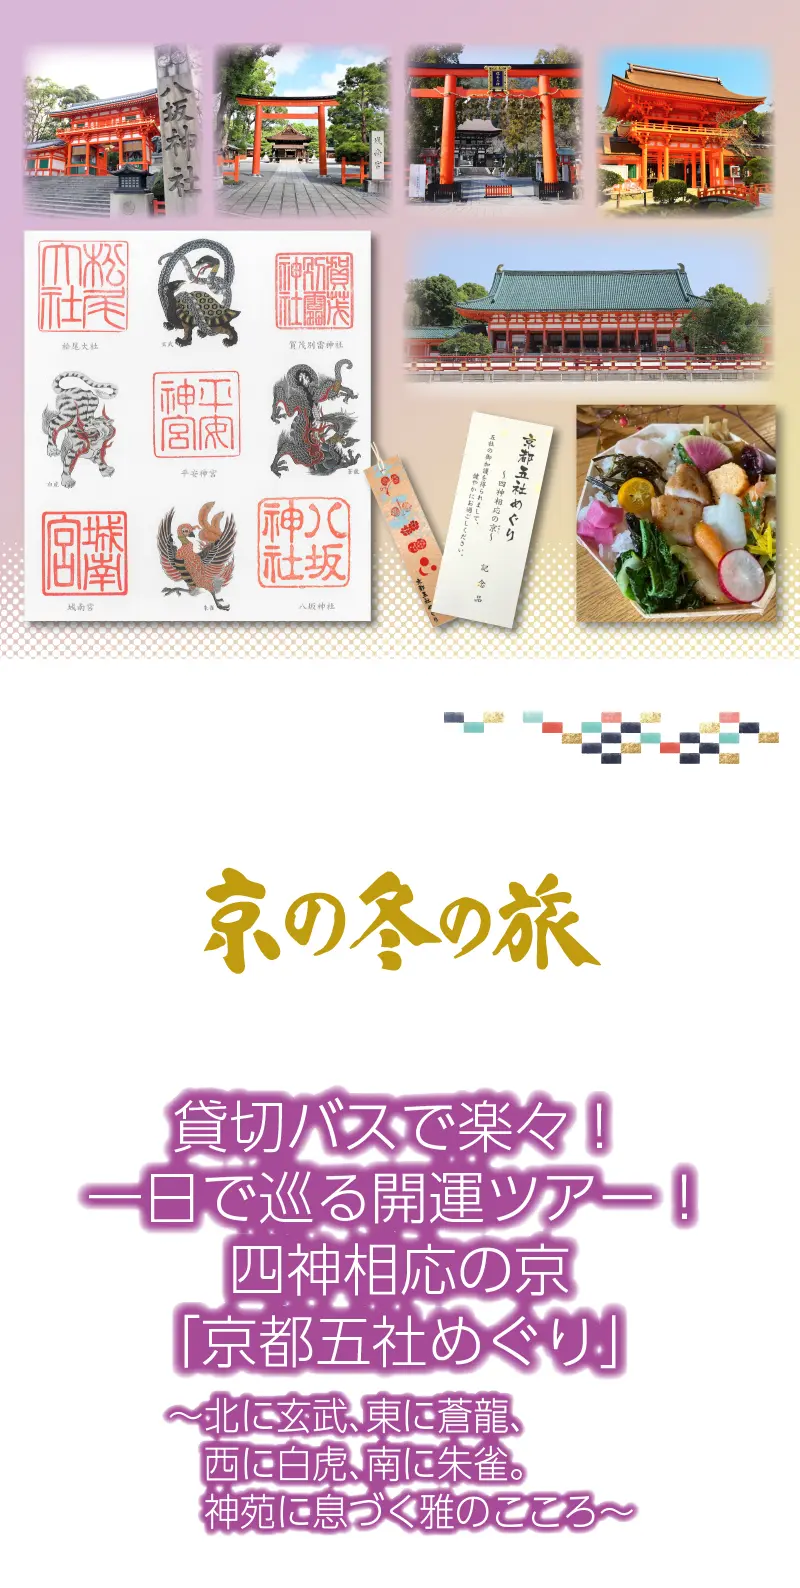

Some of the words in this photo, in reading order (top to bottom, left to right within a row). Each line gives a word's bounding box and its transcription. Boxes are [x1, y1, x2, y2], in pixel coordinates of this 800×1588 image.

[160, 81, 200, 198] 八坂神社
[505, 433, 537, 542] 京都五社めぐり
[204, 868, 601, 974] 京の冬の旅
[232, 1242, 569, 1296] 四神相応の京
[184, 1314, 616, 1369] 「京都五社めぐり」
[205, 1445, 523, 1482] 西に白虎、南に朱雀。
